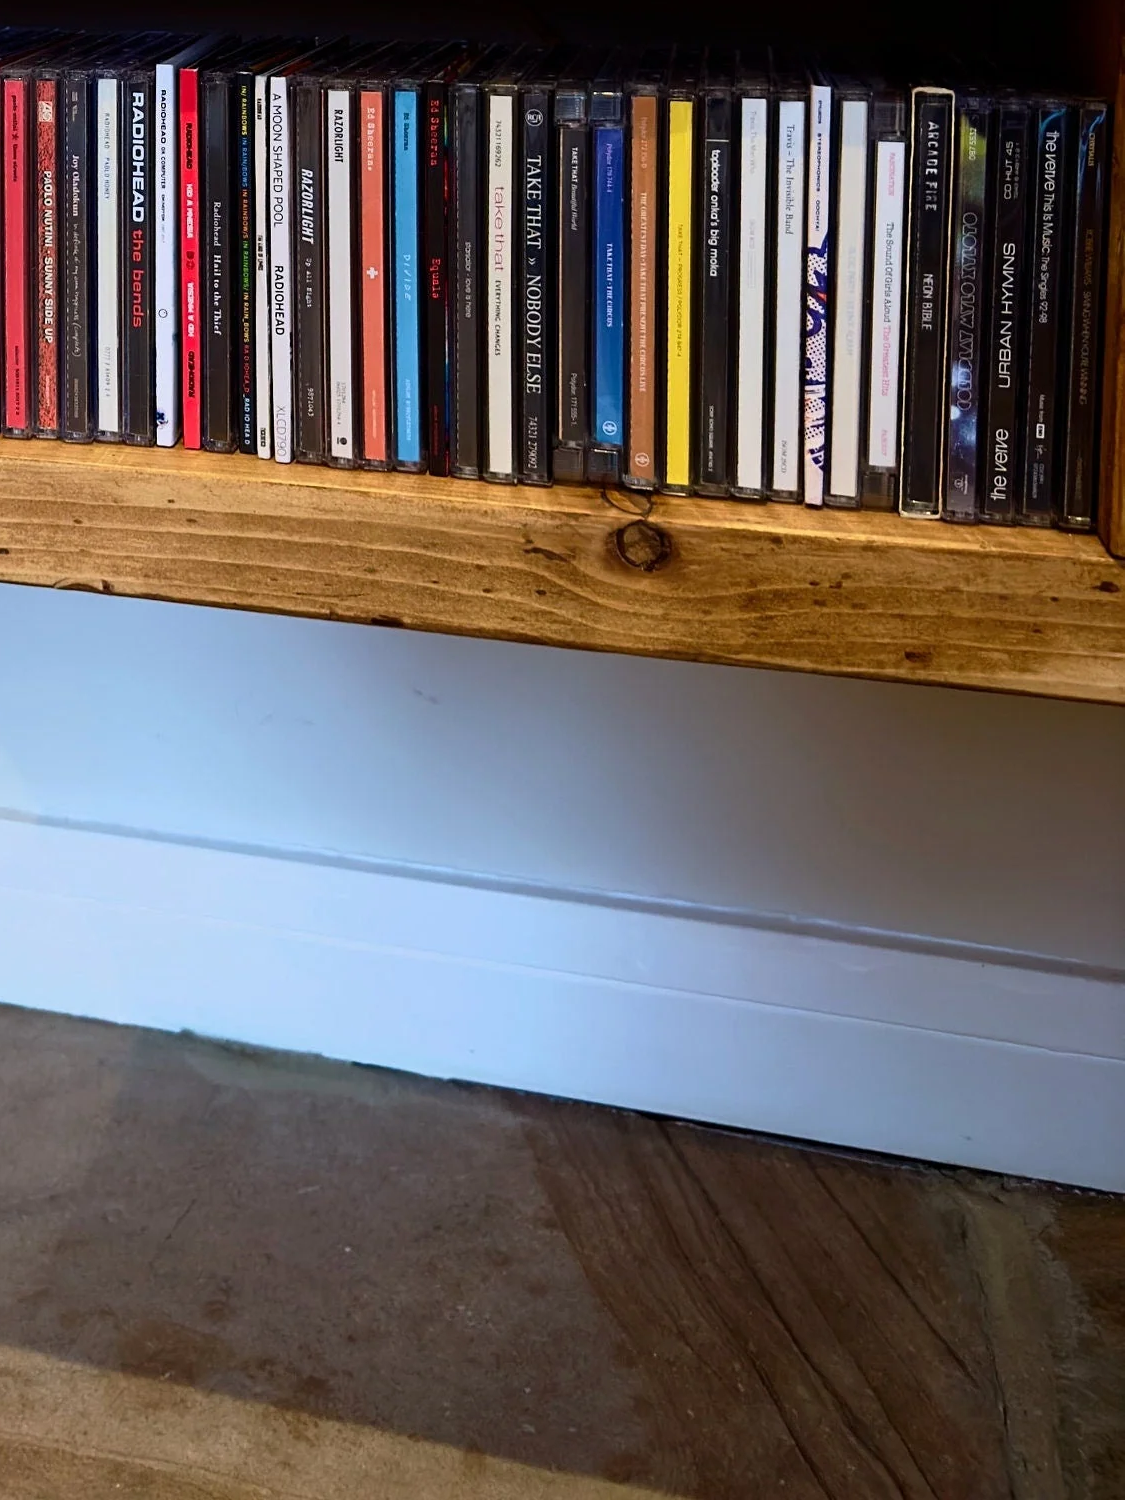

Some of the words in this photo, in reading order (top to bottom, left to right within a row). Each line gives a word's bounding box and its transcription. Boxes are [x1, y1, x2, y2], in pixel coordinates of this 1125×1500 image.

[273, 93, 282, 101] A
[273, 105, 282, 141] MOON
[334, 109, 343, 163] RAZORLIGHT
[786, 124, 795, 148] Travis
[132, 92, 145, 222] RADIOHEAD
[926, 121, 939, 175] ARCADE
[1005, 141, 1013, 155] 45
[1045, 131, 1059, 152] the
[273, 146, 283, 192] SHAPED
[526, 155, 541, 200] TAKE
[710, 150, 721, 192] toploader
[786, 159, 795, 174] The
[1044, 154, 1056, 191] verve
[43, 171, 53, 206] PAOLO
[570, 184, 578, 210] Beautiful
[785, 177, 795, 211] Invisible
[925, 181, 937, 211] FIRE
[1004, 184, 1012, 199] CD
[1043, 194, 1054, 212] This
[213, 201, 221, 246] Radiohead
[273, 197, 283, 227] POOL
[526, 204, 541, 249] THAT
[710, 195, 720, 226] onka's
[785, 214, 794, 234] Band
[44, 209, 53, 247] NUTINI
[708, 229, 720, 245] big
[132, 229, 144, 263] the
[961, 212, 978, 279] XYLOTO
[44, 256, 53, 295] SUNNY
[213, 254, 221, 276] Hail
[709, 248, 718, 276] moka
[1040, 257, 1050, 270] The
[213, 279, 220, 288] to
[923, 274, 933, 298] NEON
[1002, 243, 1015, 314] HYMNS
[1038, 272, 1049, 300] Singles
[44, 298, 53, 324] SIDE
[132, 269, 144, 328] bends
[213, 291, 221, 306] the
[275, 266, 284, 335] RADIOHEAD
[526, 274, 541, 349] NOBODY
[960, 282, 976, 328] MYLO
[1038, 302, 1049, 324] 92-98
[213, 309, 222, 335] Thief
[922, 302, 932, 330] BIBLE
[44, 328, 53, 344] UP
[957, 330, 974, 411] COLDPLAY
[998, 321, 1012, 388] URBAN
[526, 352, 541, 394] ELSE
[276, 406, 286, 456] XLCD790
[994, 429, 1009, 472] verve
[990, 475, 1007, 500] the
